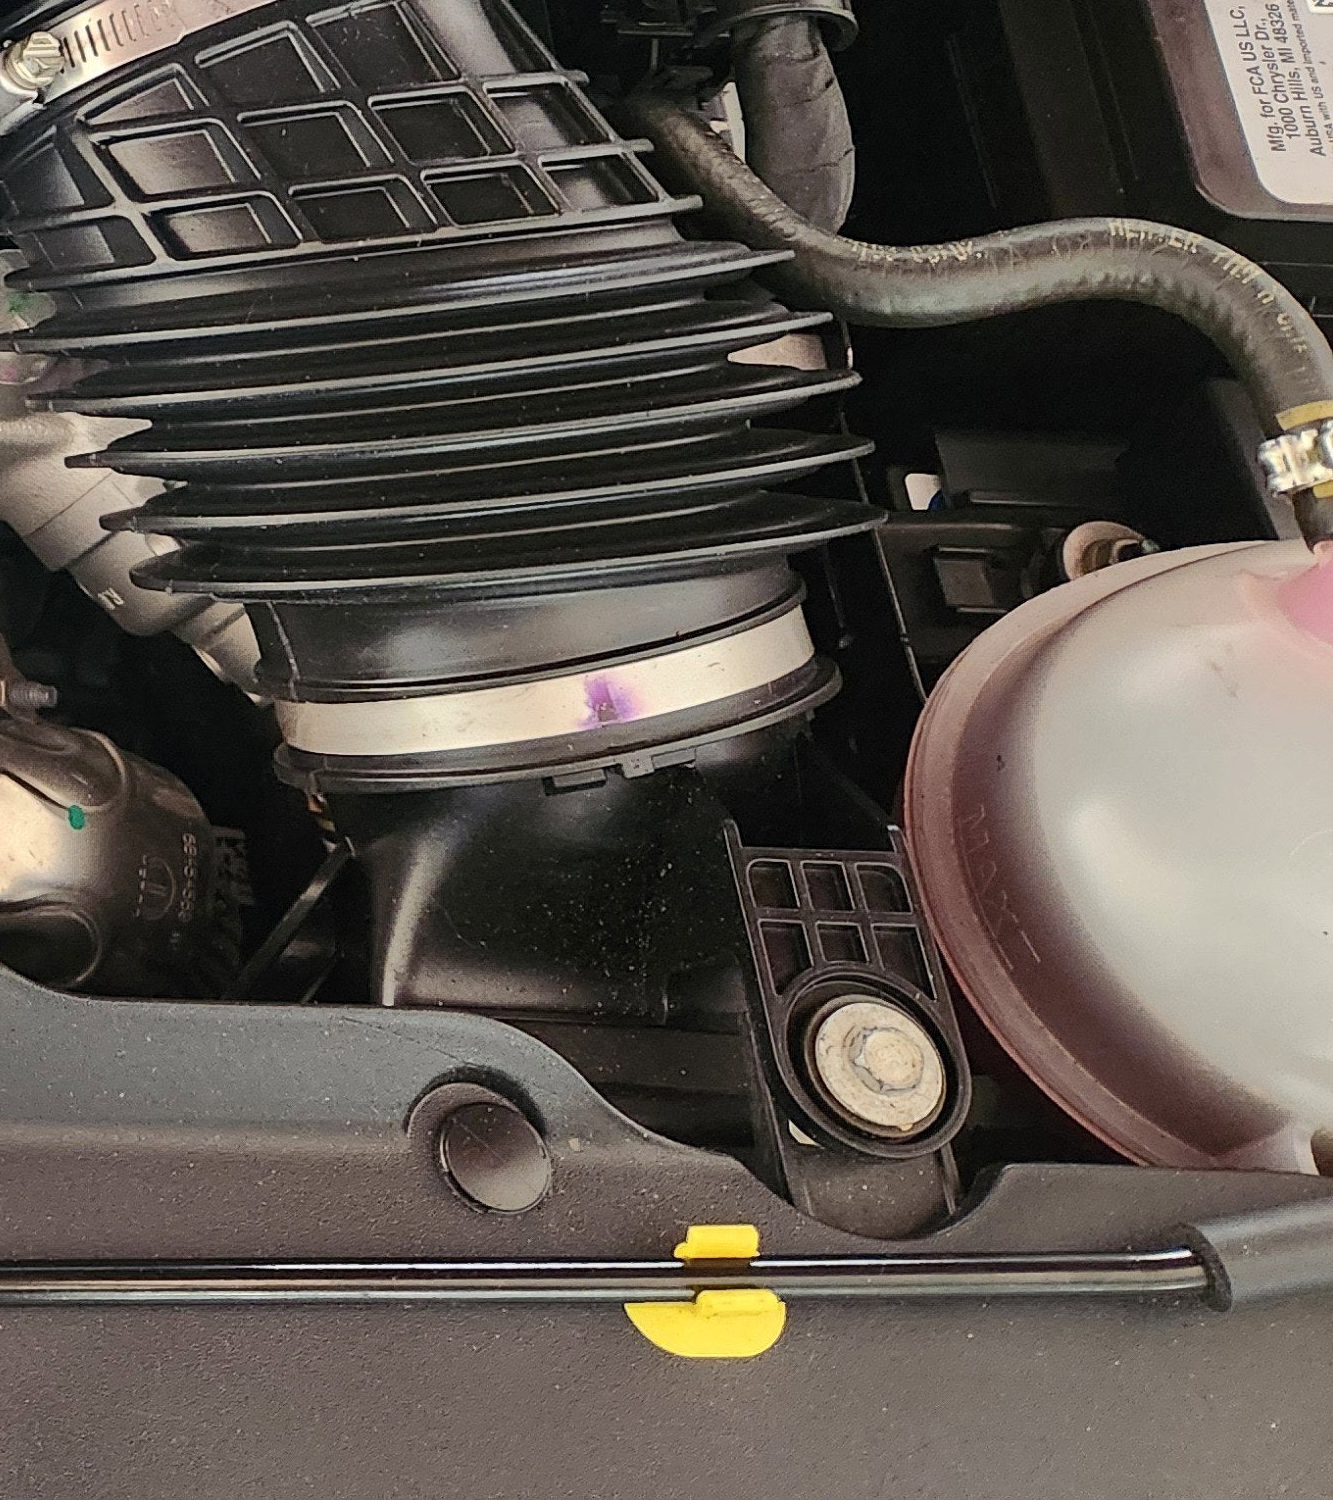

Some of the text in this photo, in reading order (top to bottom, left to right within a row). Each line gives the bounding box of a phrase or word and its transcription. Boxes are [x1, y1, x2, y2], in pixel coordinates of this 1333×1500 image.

[1228, 5, 1288, 151] Mfg. for FCA US LLC,
[1251, 18, 1301, 138] 1000 Chrysler Dr.,
[1264, 3, 1325, 155] Auburn Hills, MI 48326
[1304, 66, 1318, 83] and
[1311, 86, 1323, 98] US
[1316, 102, 1331, 119] with
